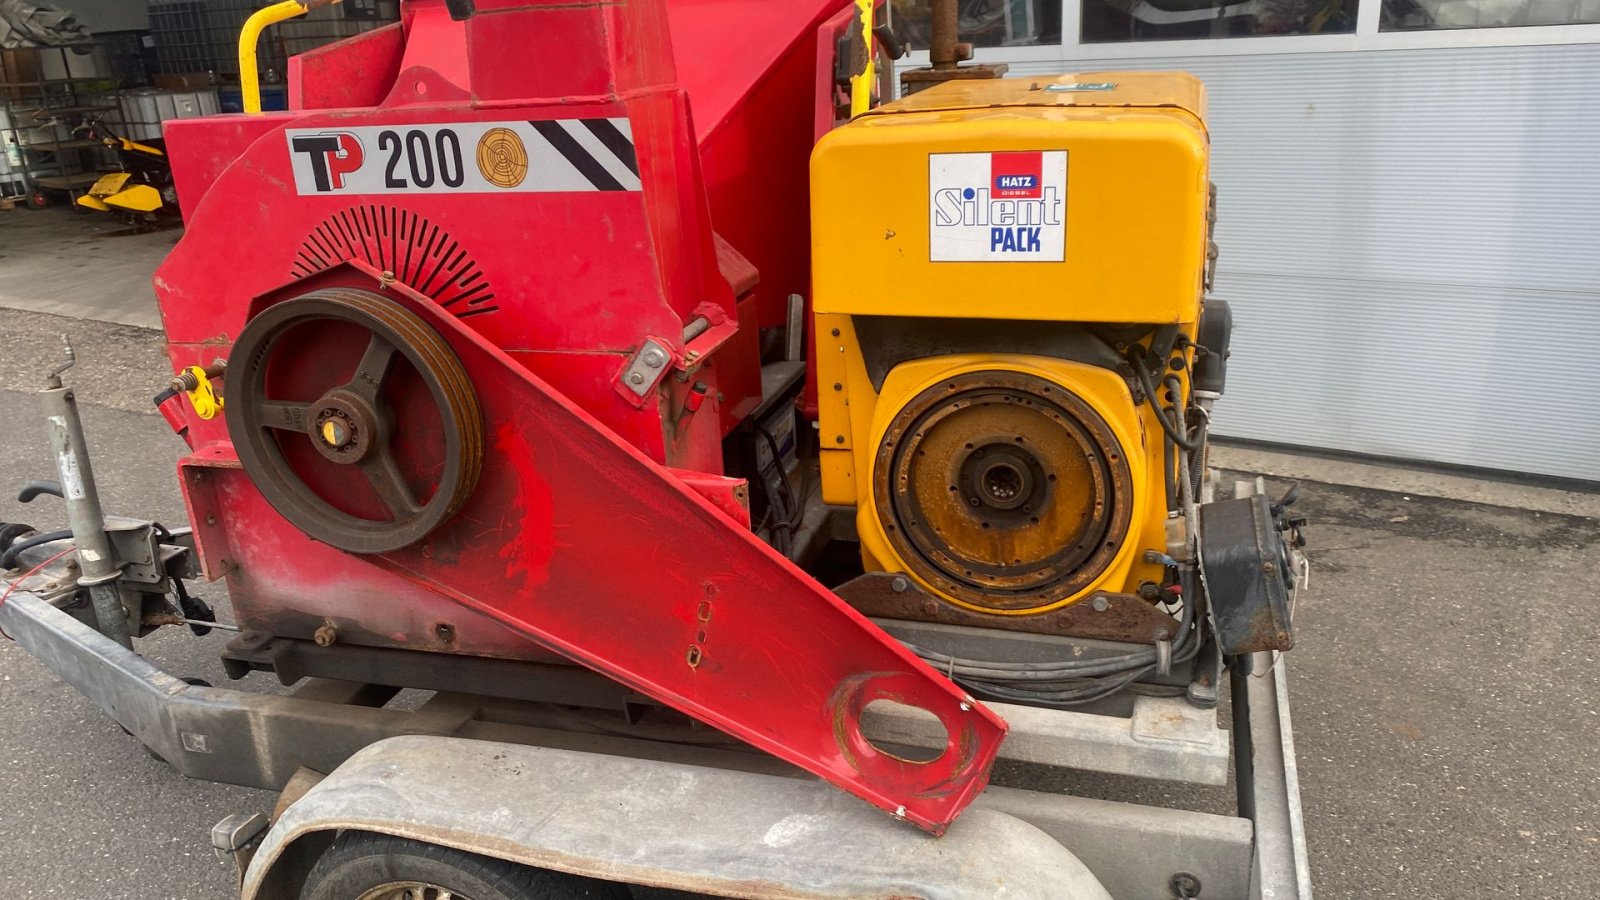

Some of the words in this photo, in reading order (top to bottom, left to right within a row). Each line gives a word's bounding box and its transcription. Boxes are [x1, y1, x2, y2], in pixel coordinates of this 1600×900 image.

[292, 131, 366, 191] TP
[378, 128, 465, 188] 200
[1001, 176, 1032, 187] HATZ
[935, 187, 1060, 226] Silent
[991, 227, 1041, 252] PACK
